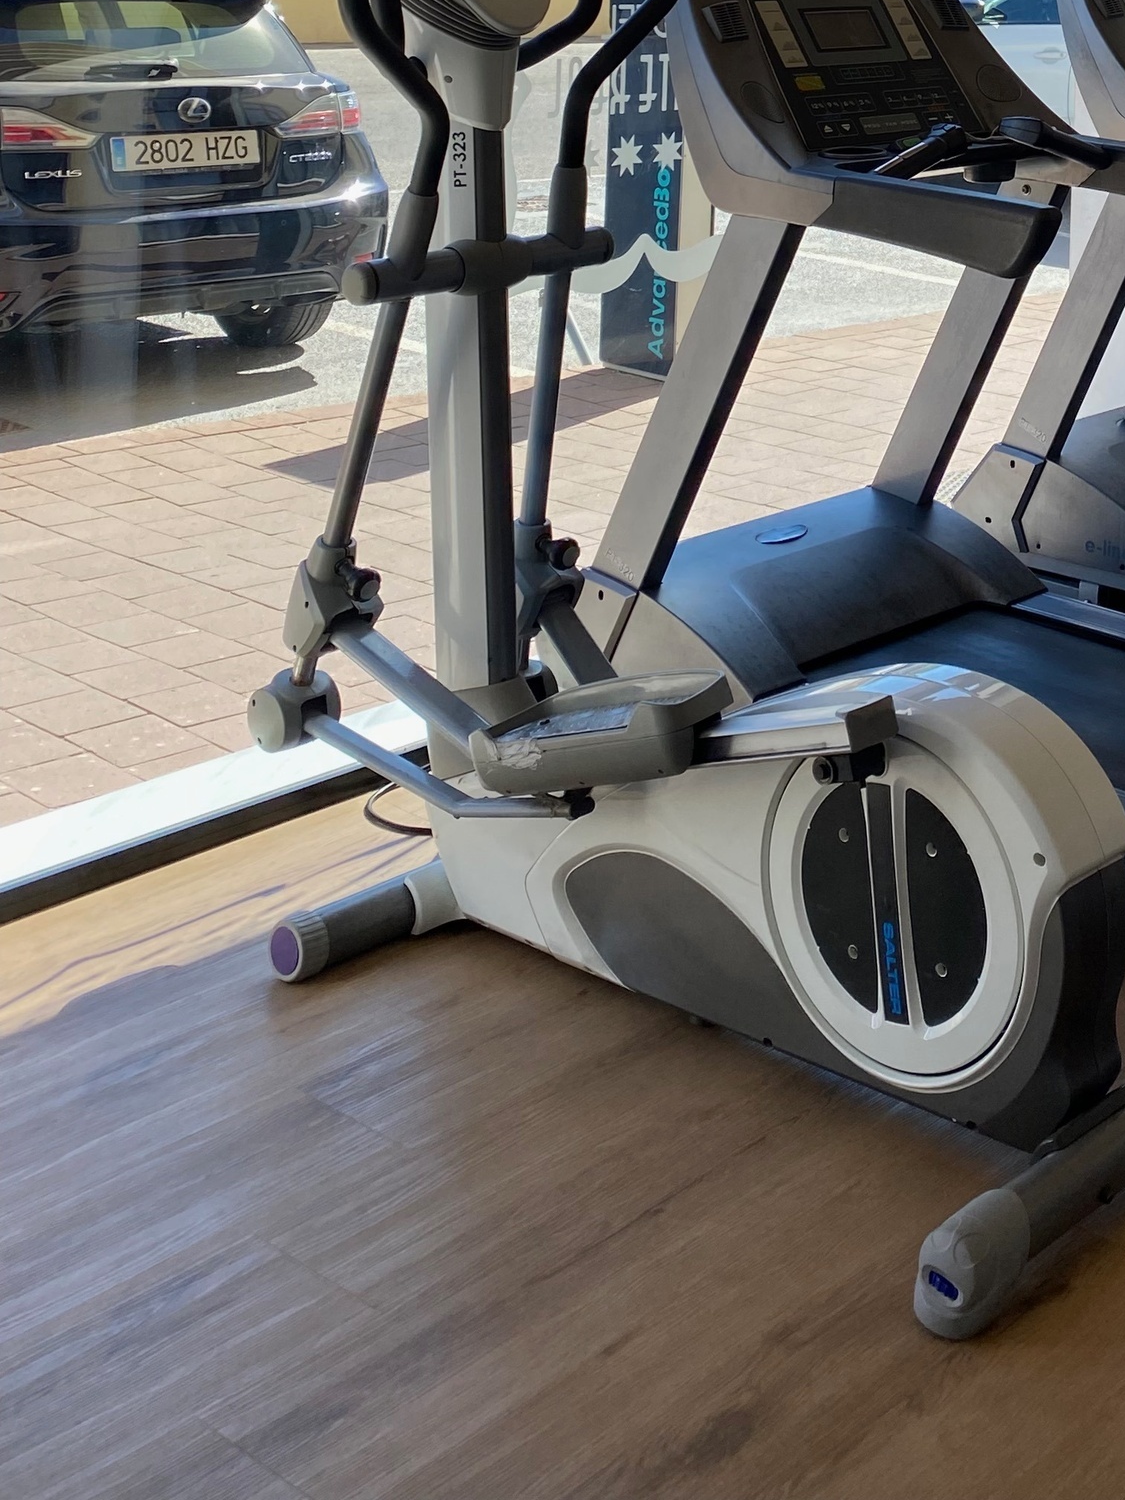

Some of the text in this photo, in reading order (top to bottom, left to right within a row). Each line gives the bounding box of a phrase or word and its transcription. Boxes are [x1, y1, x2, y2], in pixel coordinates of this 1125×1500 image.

[133, 138, 195, 165] 2802
[206, 136, 249, 161] HZG
[452, 131, 467, 188] PT-323
[24, 169, 83, 180] LEXUS
[882, 921, 902, 1015] SALTER
